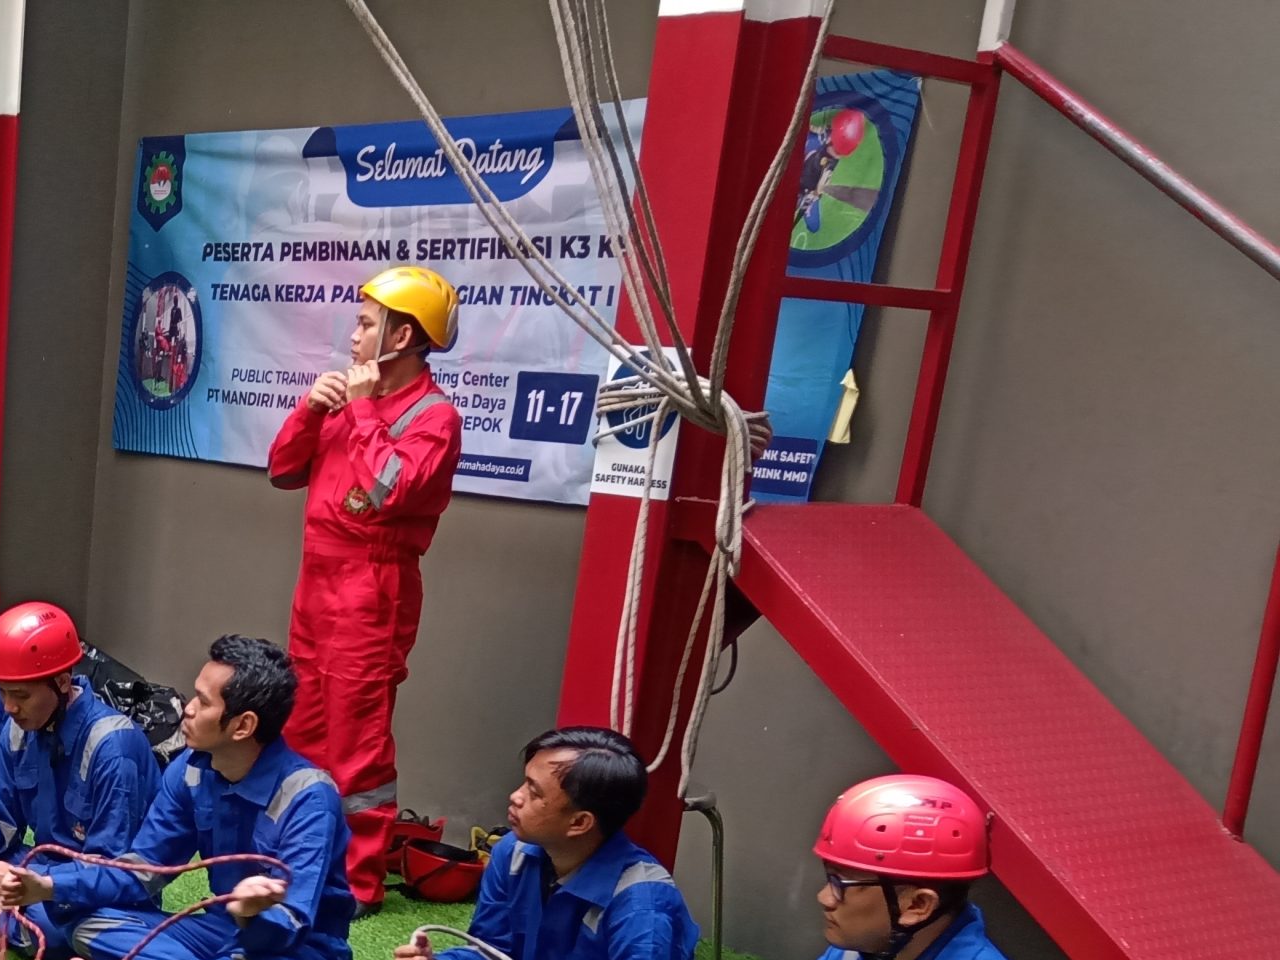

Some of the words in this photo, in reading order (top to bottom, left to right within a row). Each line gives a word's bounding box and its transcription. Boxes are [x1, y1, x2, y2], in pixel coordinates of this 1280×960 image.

[356, 141, 446, 182] Selamat
[454, 137, 545, 185] Datang
[201, 242, 275, 262] PESERTA
[279, 239, 391, 262] PEMBINAAN
[396, 239, 410, 261] &
[415, 235, 552, 261] SERTIFIKASI
[560, 235, 591, 259] K3
[210, 283, 272, 302] TENAGA
[275, 284, 325, 303] KERJA
[509, 285, 602, 307] TINGKAT
[606, 285, 615, 307] I
[231, 368, 274, 384] PUBLIC
[276, 370, 321, 386] TRAINI
[462, 371, 510, 388] Center
[206, 388, 220, 403] PT
[221, 389, 274, 408] MANDIRI
[471, 394, 506, 414] Daya
[595, 473, 627, 485] SAFETY
[627, 476, 668, 489] HARESS
[783, 470, 808, 483] MMD
